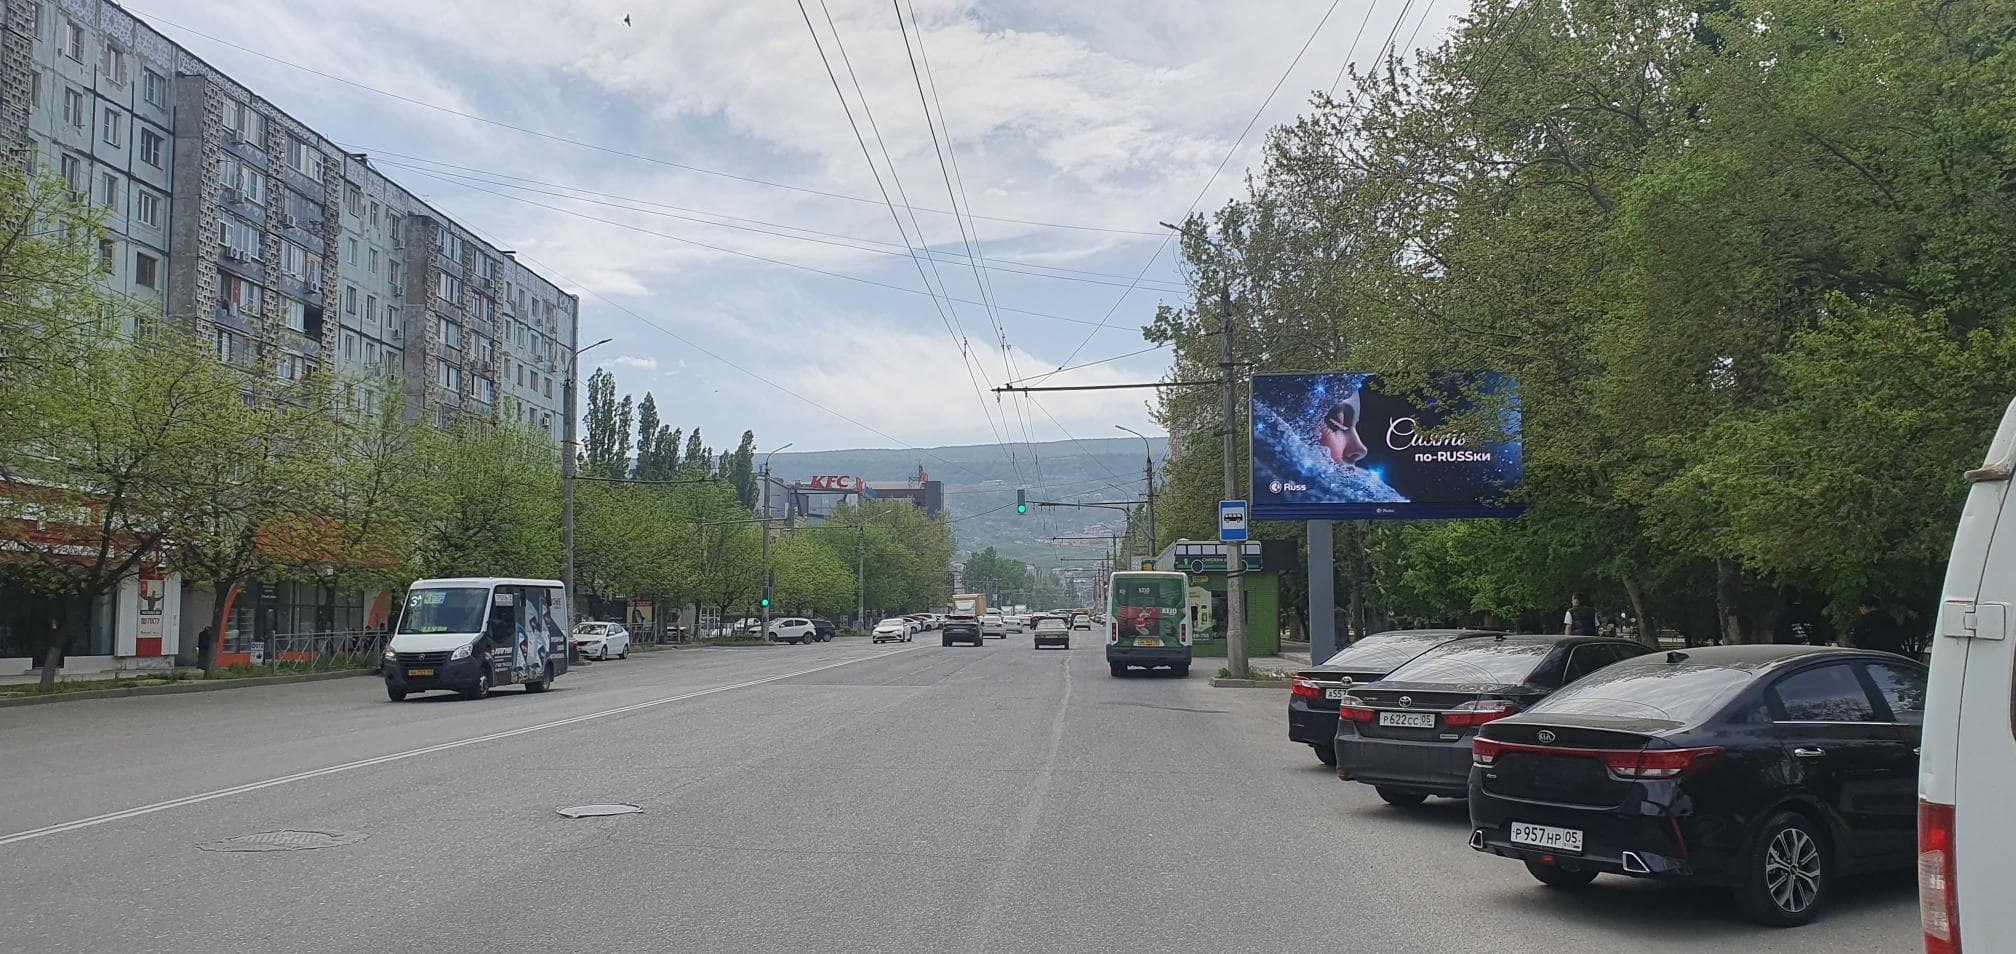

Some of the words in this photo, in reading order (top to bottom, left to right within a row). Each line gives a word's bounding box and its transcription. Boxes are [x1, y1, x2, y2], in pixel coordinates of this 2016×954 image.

[1415, 450, 1491, 462] по-RUSSки
[810, 475, 850, 488] KFC
[1283, 482, 1307, 492] Russ
[1539, 731, 1553, 742] KIA
[1565, 831, 1578, 844] 05
